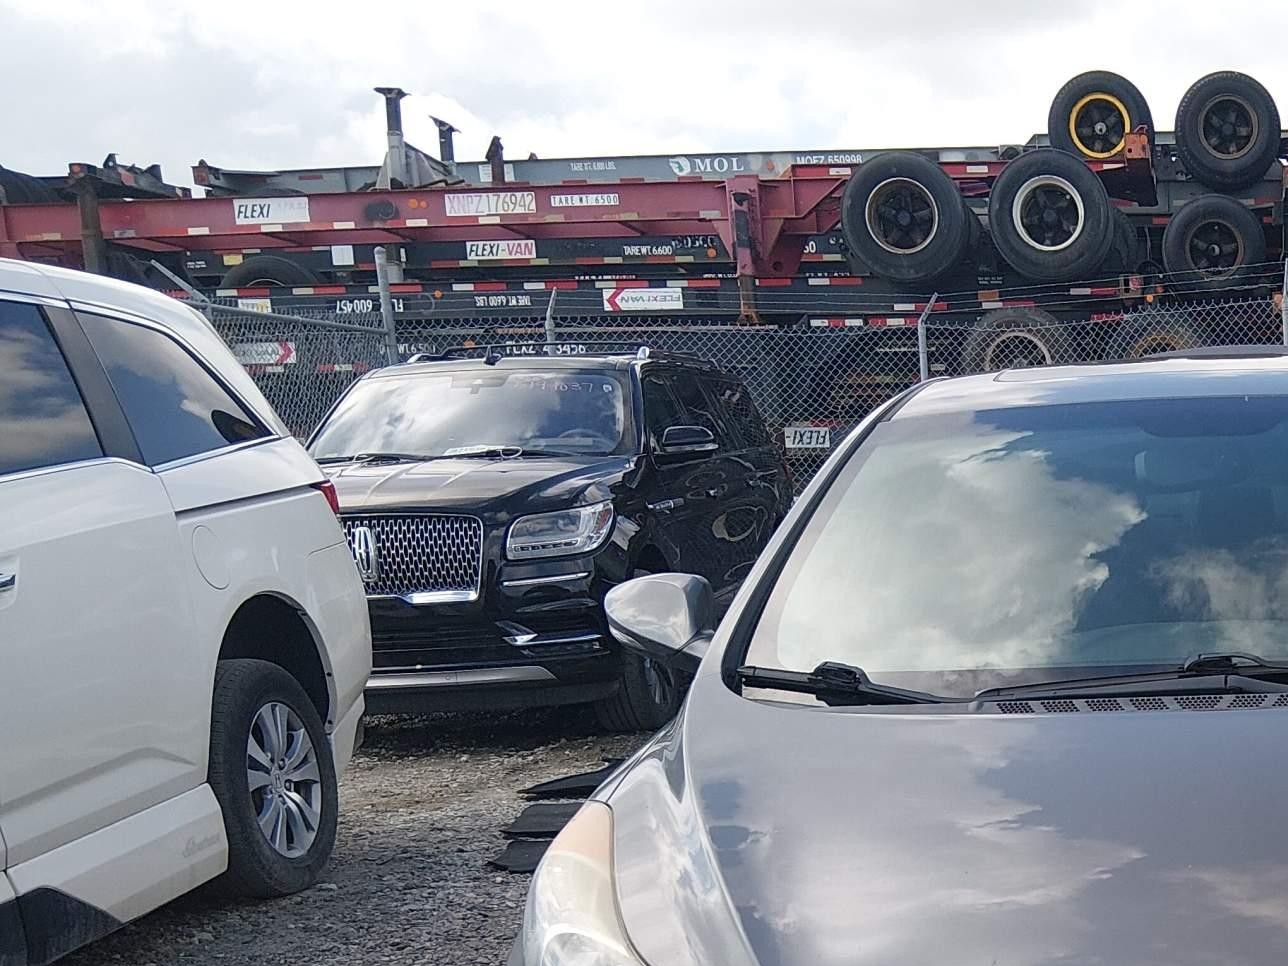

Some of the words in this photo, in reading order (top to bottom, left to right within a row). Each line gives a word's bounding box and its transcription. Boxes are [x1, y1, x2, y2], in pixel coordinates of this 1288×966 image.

[694, 157, 744, 172] MOL
[236, 204, 271, 219] FLEXI
[468, 242, 534, 257] FLEXI-VAN
